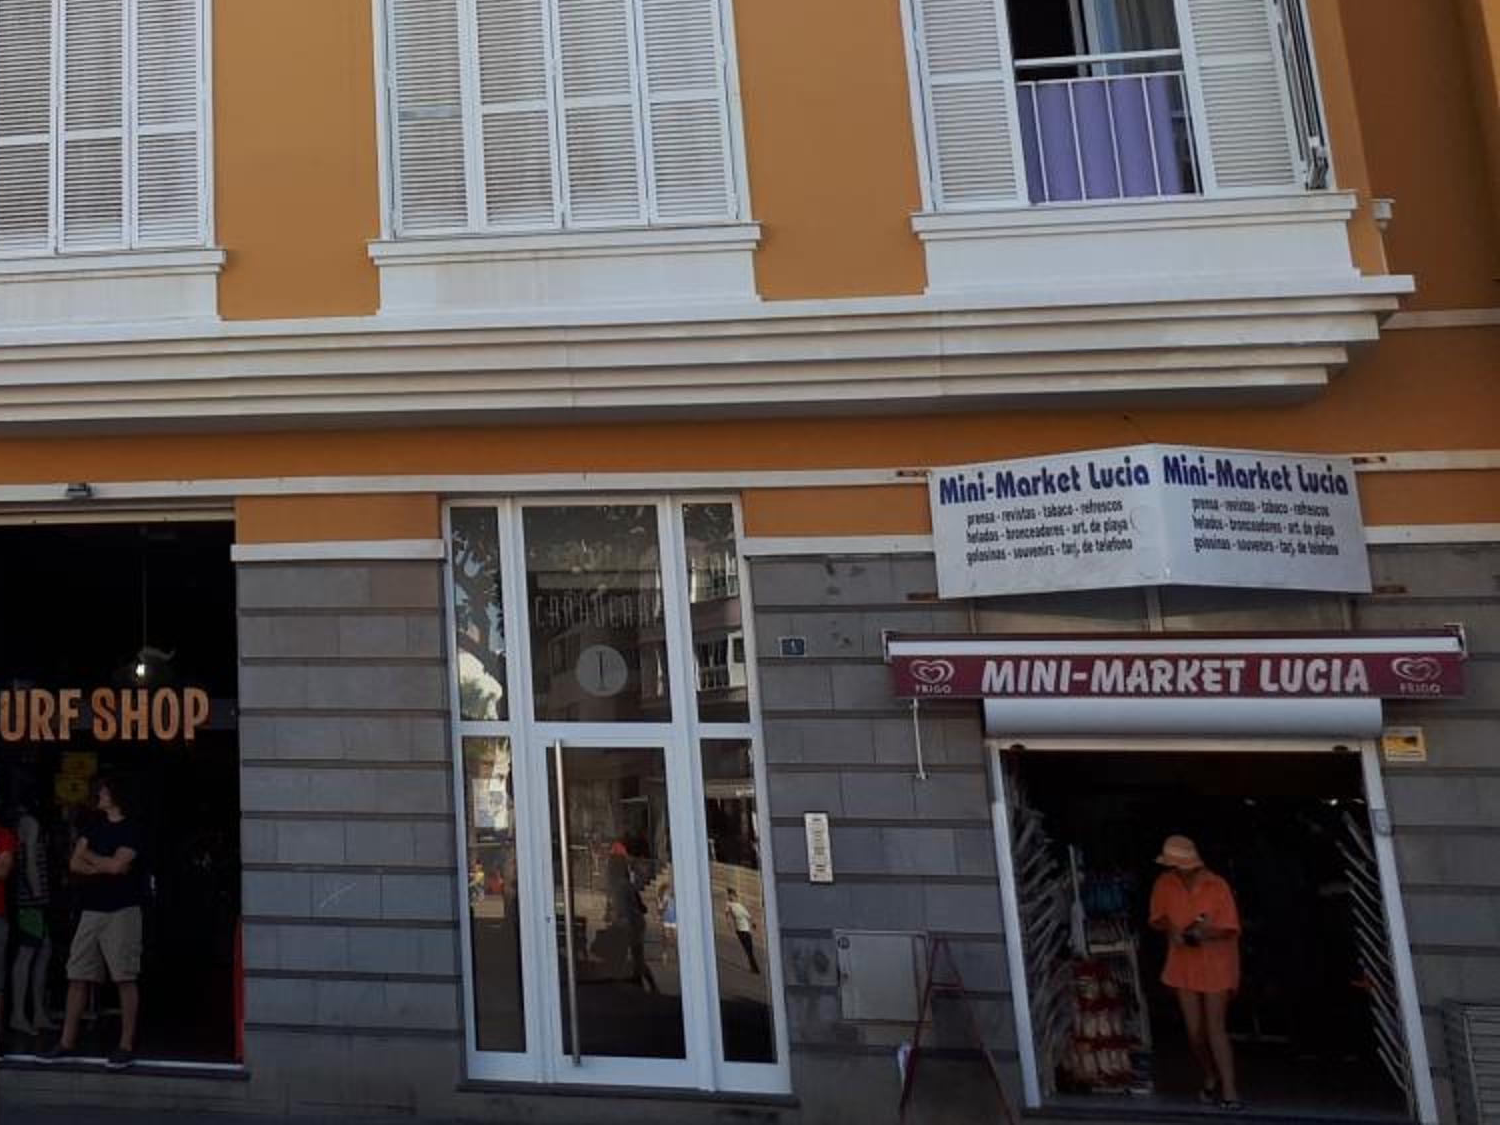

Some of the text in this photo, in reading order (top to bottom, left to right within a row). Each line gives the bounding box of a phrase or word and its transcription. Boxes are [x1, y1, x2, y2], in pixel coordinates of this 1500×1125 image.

[940, 455, 1150, 505] Mini-Market Lucia
[1162, 454, 1349, 495] Mini-Market Lucia
[966, 529, 999, 543] helados
[1090, 519, 1101, 533] de
[1103, 517, 1129, 535] playa
[967, 499, 1123, 527] prensa revistas tabaco refrescos
[1013, 542, 1055, 559] souvenirs
[1082, 540, 1093, 554] de
[982, 658, 1369, 693] MINI-MARKET LUCIA
[91, 686, 210, 743] SHOP
